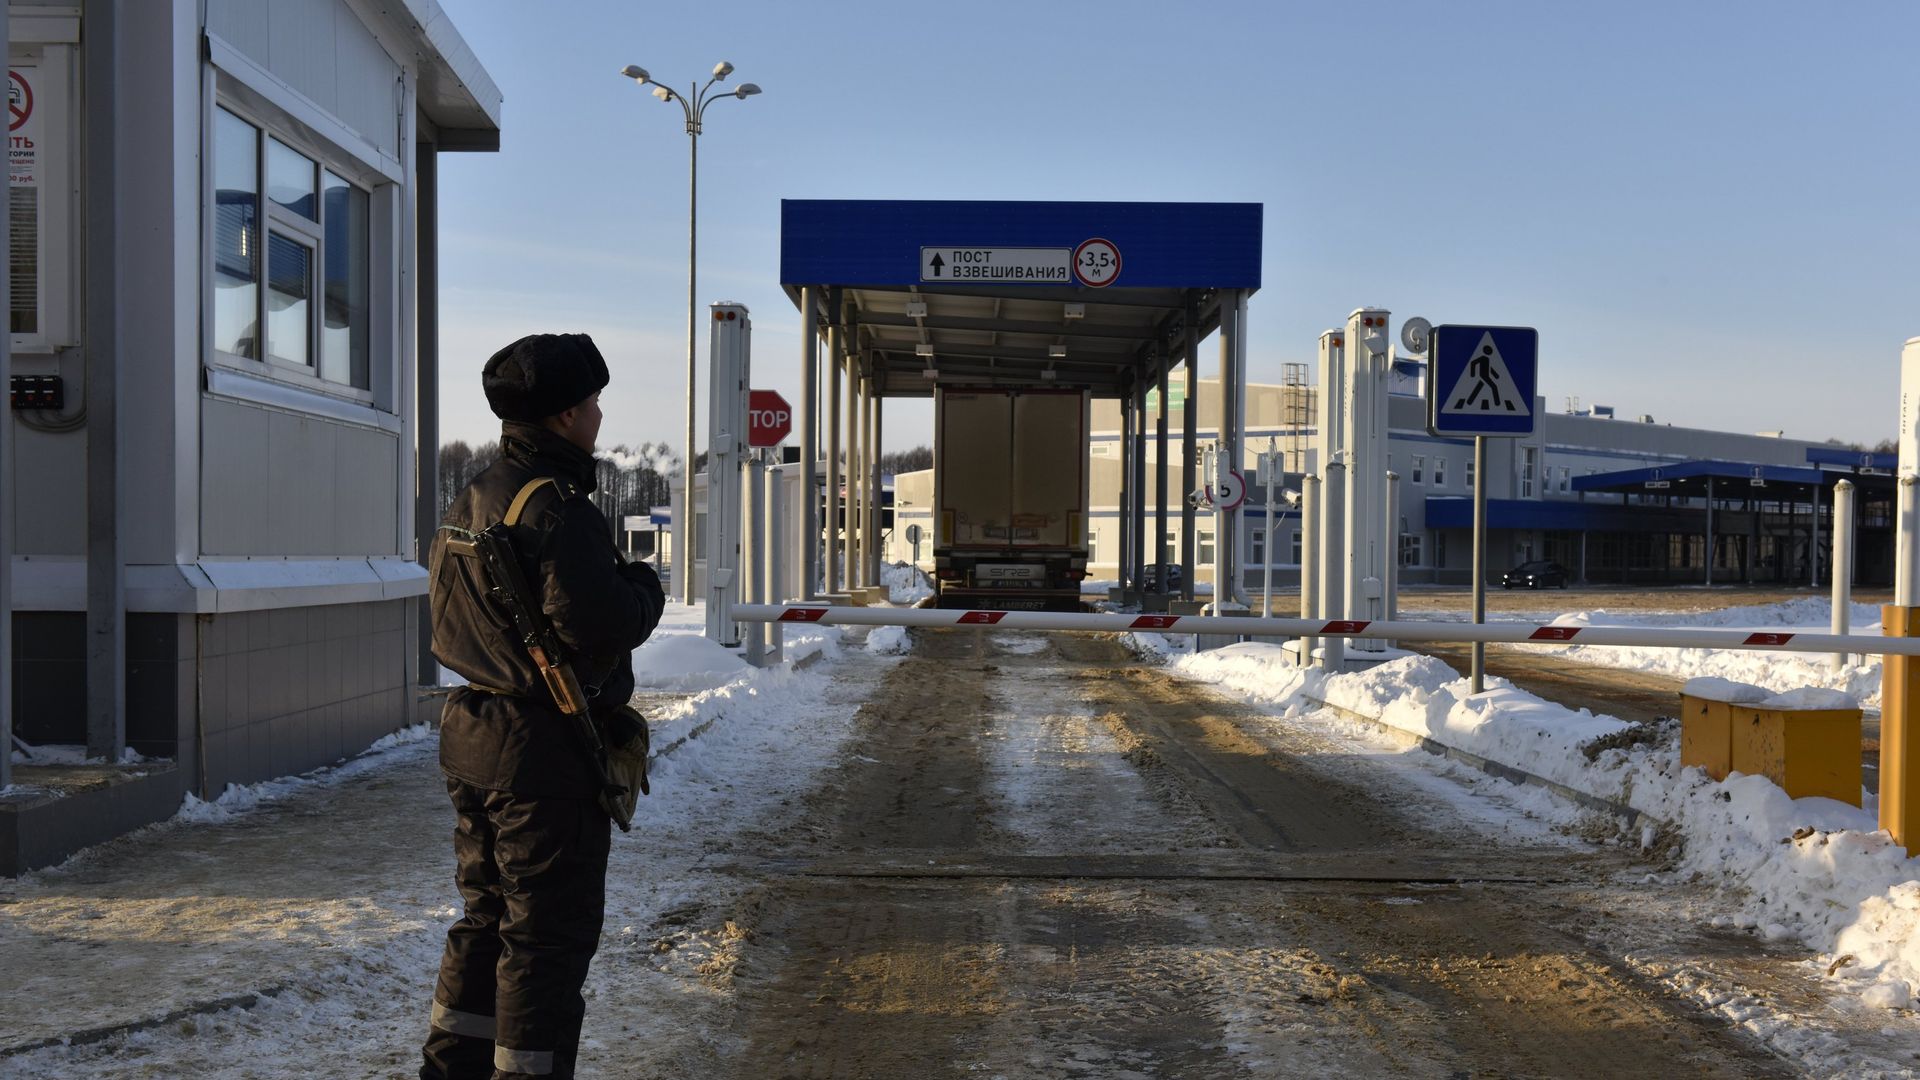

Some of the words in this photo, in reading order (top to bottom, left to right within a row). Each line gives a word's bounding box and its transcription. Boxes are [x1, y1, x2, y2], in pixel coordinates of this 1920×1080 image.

[953, 251, 992, 263] ПОСТ
[1085, 251, 1109, 268] 3,5
[953, 266, 1066, 279] ВЗВЕШИВАНИЯ
[750, 410, 788, 428] TOP
